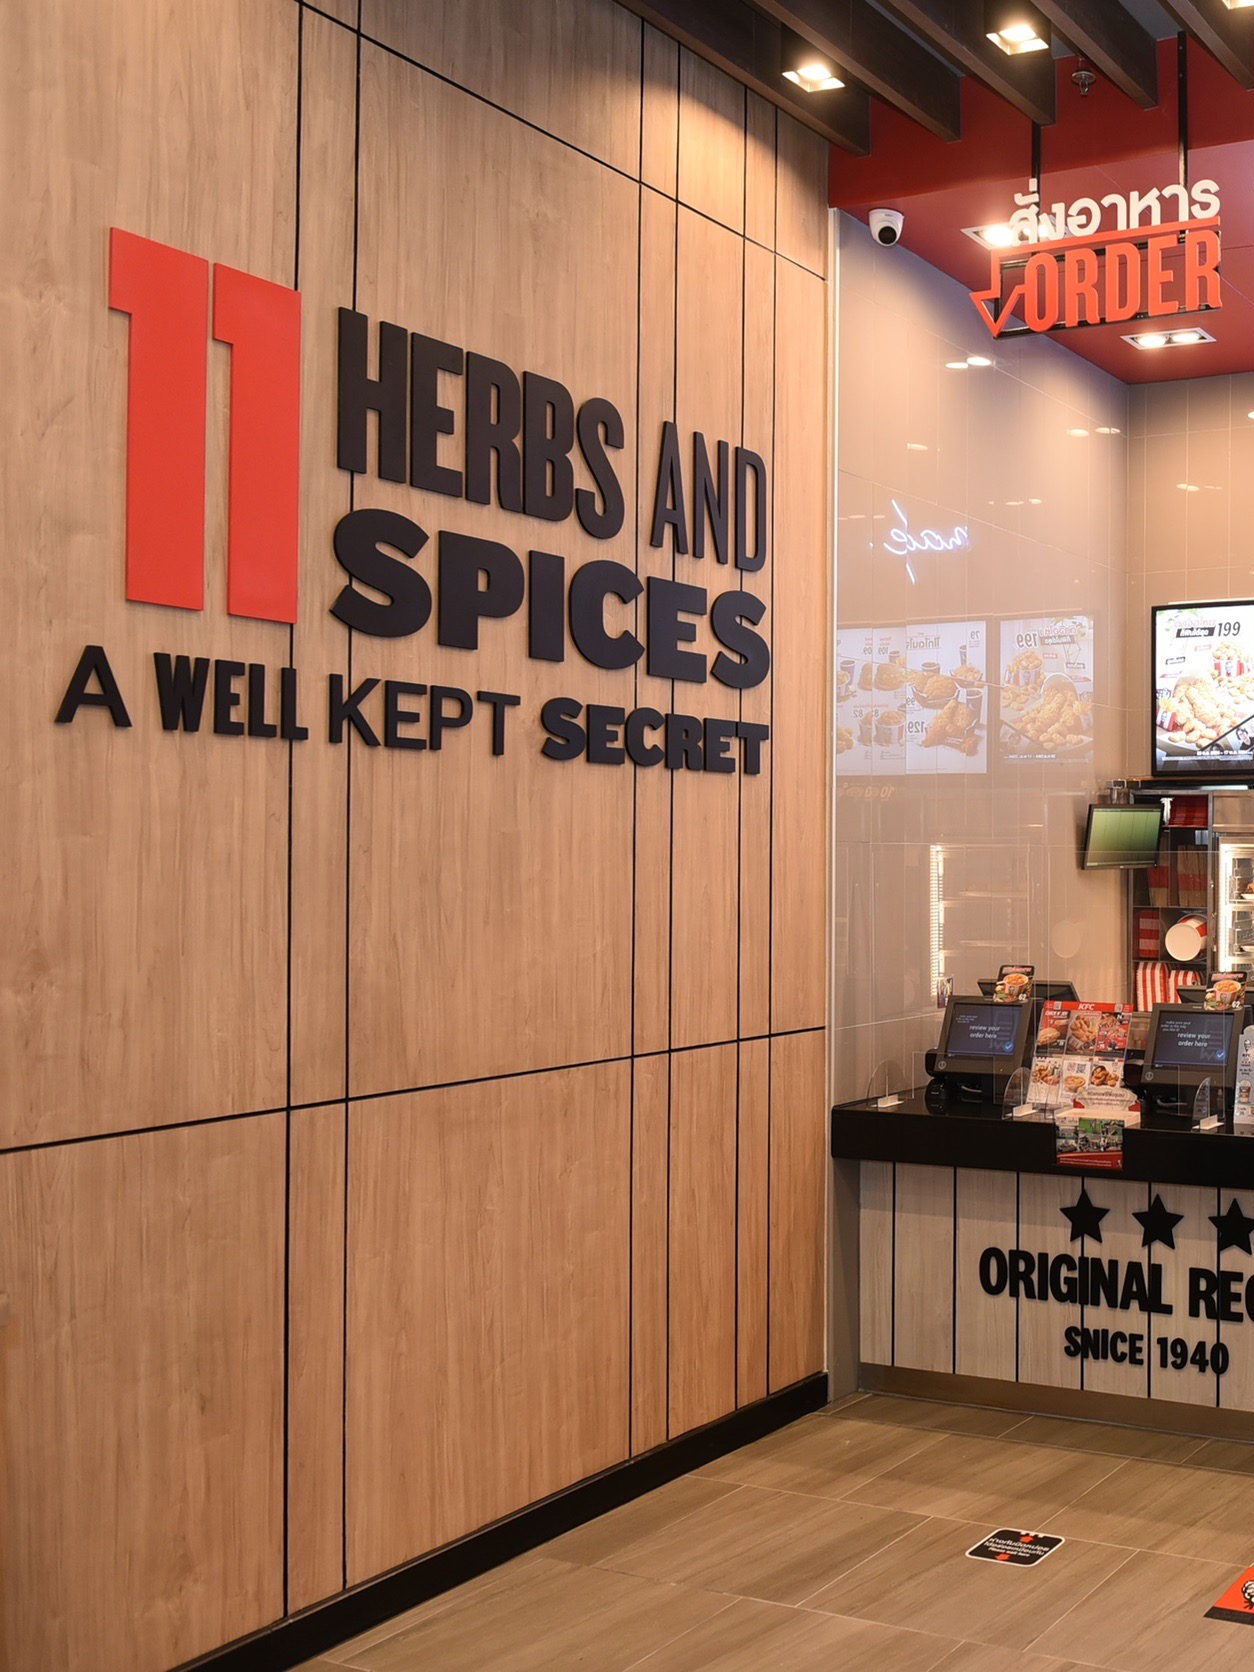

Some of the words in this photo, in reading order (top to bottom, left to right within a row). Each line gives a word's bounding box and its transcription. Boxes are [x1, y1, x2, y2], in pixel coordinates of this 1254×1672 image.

[1009, 178, 1221, 247] สั่งอาหาร
[1024, 229, 1223, 333] ORDER
[108, 227, 302, 625] 11
[337, 306, 626, 540] HERBS
[650, 420, 769, 573] AND
[329, 508, 771, 690] SPICES
[1218, 621, 1241, 637] 199
[54, 645, 133, 729] A
[153, 652, 309, 741] WELL
[329, 673, 521, 757] KEPT
[540, 697, 770, 775] SECRET
[979, 1246, 1173, 1315] ORIGINAL
[1064, 1325, 1145, 1366] SNICE
[1156, 1336, 1230, 1376] 1940
